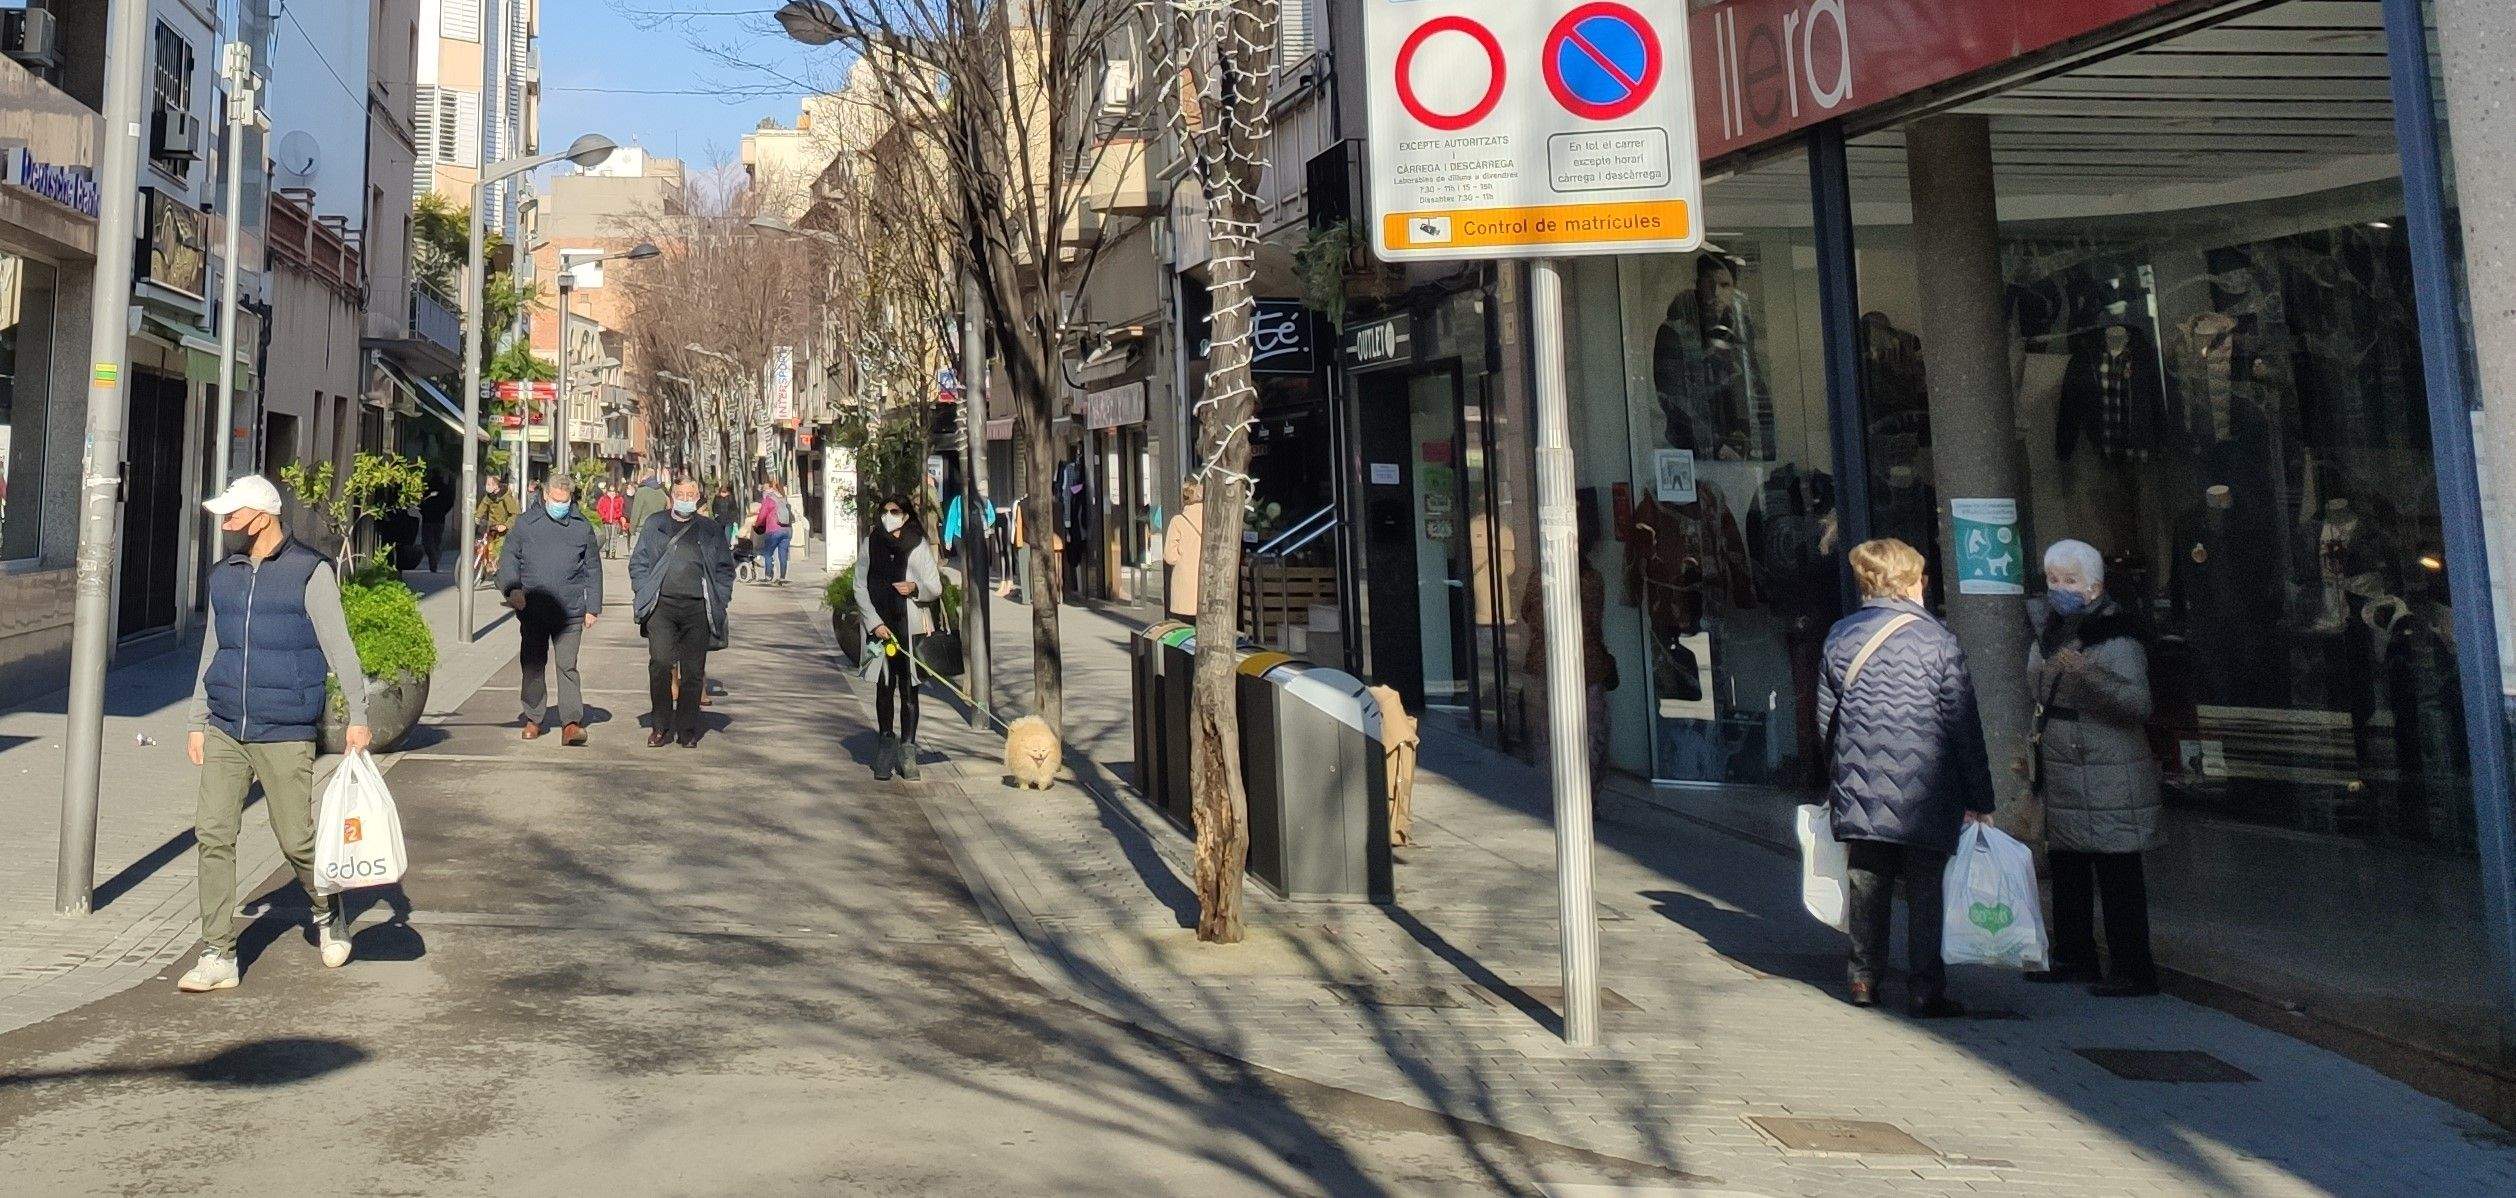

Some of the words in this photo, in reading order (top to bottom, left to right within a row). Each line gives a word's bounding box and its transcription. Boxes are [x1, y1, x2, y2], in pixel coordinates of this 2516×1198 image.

[1399, 141, 1440, 151] EXCEPTE
[1444, 136, 1510, 149] AUTORITZATS
[1569, 142, 1582, 151] En
[1586, 140, 1598, 150] tot
[1602, 140, 1612, 149] el
[1615, 139, 1645, 149] carrer
[1573, 156, 1611, 167] excepte
[1615, 154, 1644, 164] horari
[20, 147, 72, 206] Deutsche
[1482, 171, 1518, 180] divendres
[1557, 173, 1595, 183] càrrega
[1605, 169, 1662, 181] descàrrega
[1464, 218, 1528, 236] Control
[1535, 217, 1557, 233] de
[1565, 214, 1661, 232] matrícules
[1357, 325, 1385, 361] OUTLET
